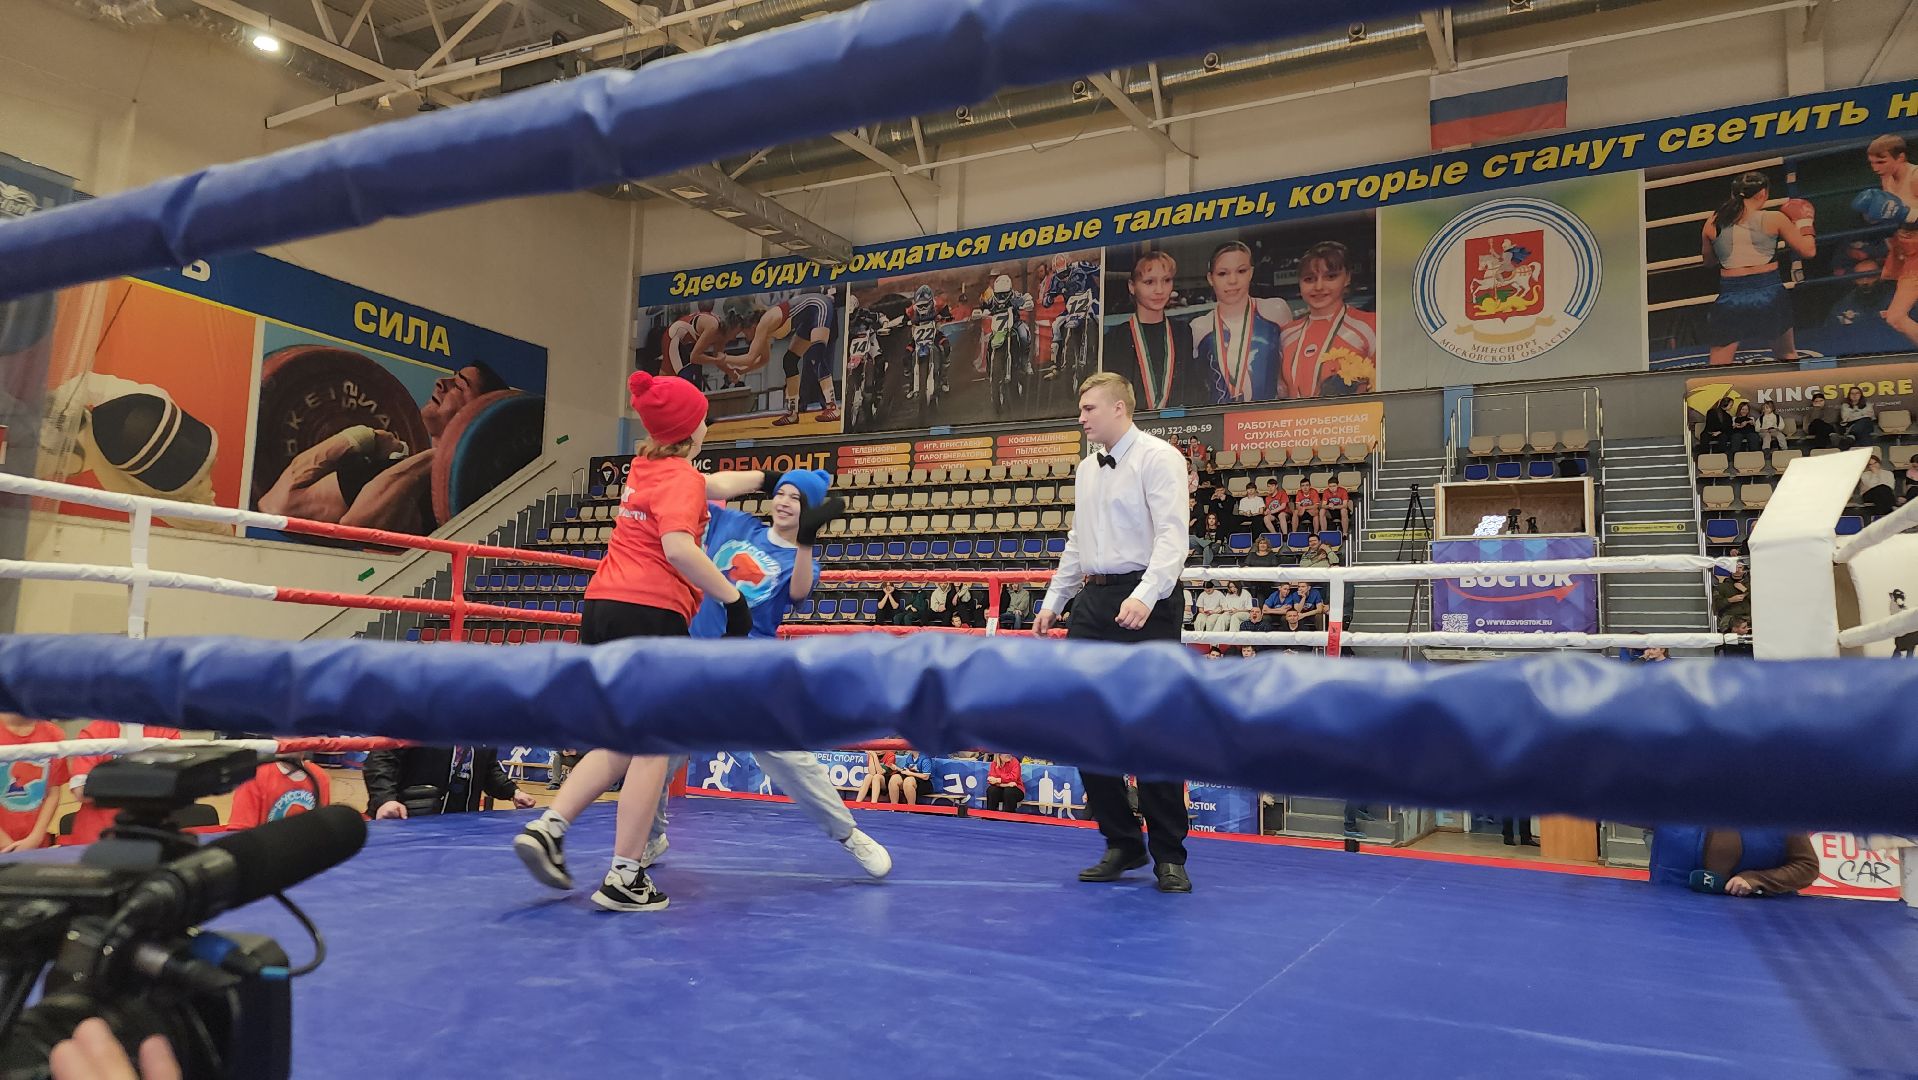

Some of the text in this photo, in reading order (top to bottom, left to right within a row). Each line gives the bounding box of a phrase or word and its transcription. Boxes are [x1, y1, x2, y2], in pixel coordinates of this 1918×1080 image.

[669, 270, 743, 297] Здесь
[751, 261, 821, 289] будут
[829, 235, 991, 281] рождаться
[998, 218, 1102, 251] новые
[1112, 191, 1276, 235] таланты,
[1288, 159, 1470, 210] которые
[1481, 132, 1646, 180] станут
[1657, 98, 1870, 153] светить
[1074, 299, 1090, 314] 12
[353, 301, 451, 357] СИЛА
[995, 316, 1006, 331] 7
[915, 327, 935, 342] 22
[852, 340, 869, 354] 14
[1440, 327, 1572, 362] МОСКОВСКОЙ ОБЛАСТИ
[1471, 338, 1538, 354] МИНСПОРТ
[1167, 424, 1213, 435] 322-89-59
[1237, 413, 1369, 431] РАБОТАЕТ КУРЬЕРСКАЯ
[1008, 433, 1068, 444] КОФЕМАШИНЫ
[1244, 425, 1361, 440] СЛУЖБА ПО МОСКВЕ
[851, 444, 897, 455] ТЕЛЕВИЗОРЫ
[940, 439, 983, 449] ПРИСТАВКИ
[1230, 434, 1376, 451] И МОСКОВСКОЙ ОБЛАСТИ
[919, 450, 988, 461] ПАРОГЕНЕРАТОРЫ
[1015, 446, 1061, 455] ПЫЛЕСОСЫ
[853, 456, 893, 465] ТЕЛЕФОНЫ
[833, 753, 864, 764] СПОРТА
[1837, 860, 1893, 886] CAR
